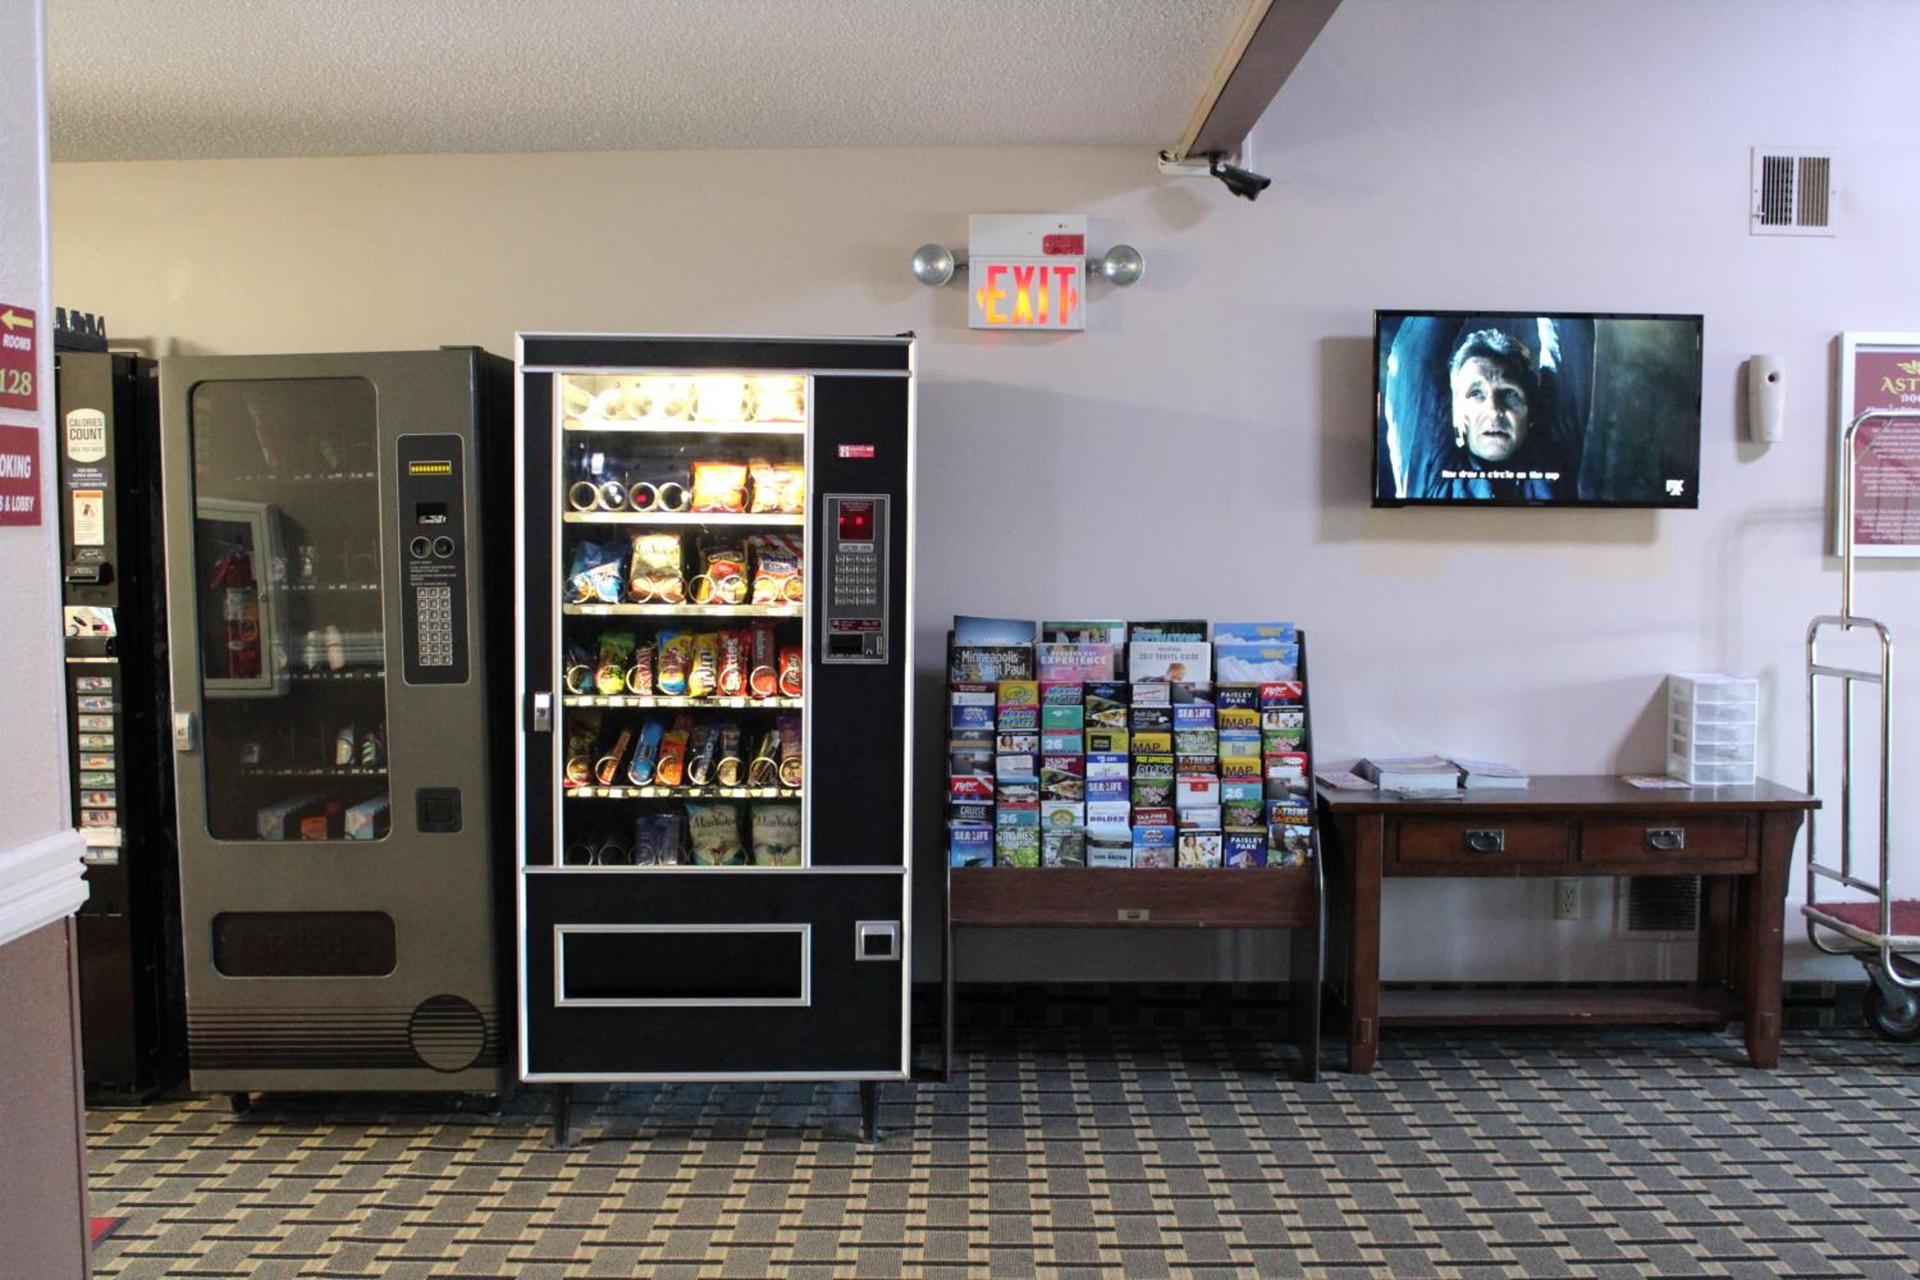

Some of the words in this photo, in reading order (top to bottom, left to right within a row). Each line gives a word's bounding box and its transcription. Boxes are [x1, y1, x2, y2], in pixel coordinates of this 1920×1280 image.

[984, 265, 1077, 325] EXIT
[3, 333, 31, 351] ROOMS
[70, 428, 102, 440] COUNT
[1487, 471, 1514, 479] circle
[1666, 479, 1685, 496] FX
[11, 495, 35, 512] LOBBY
[1041, 655, 1107, 665] EXPERIENCE
[1005, 662, 1025, 676] Paul
[1178, 708, 1194, 718] SEA
[1195, 708, 1211, 718] LIFE
[1045, 739, 1063, 750] 26
[1225, 766, 1254, 775] MAP
[1088, 782, 1105, 792] SEA
[1105, 782, 1122, 792] LIFE
[1225, 787, 1243, 798] 26
[960, 806, 986, 815] CRUISE
[1000, 813, 1017, 823] 26
[953, 831, 971, 840] SEA
[971, 831, 989, 840] LIFE
[1230, 836, 1264, 844] PAISLEY
